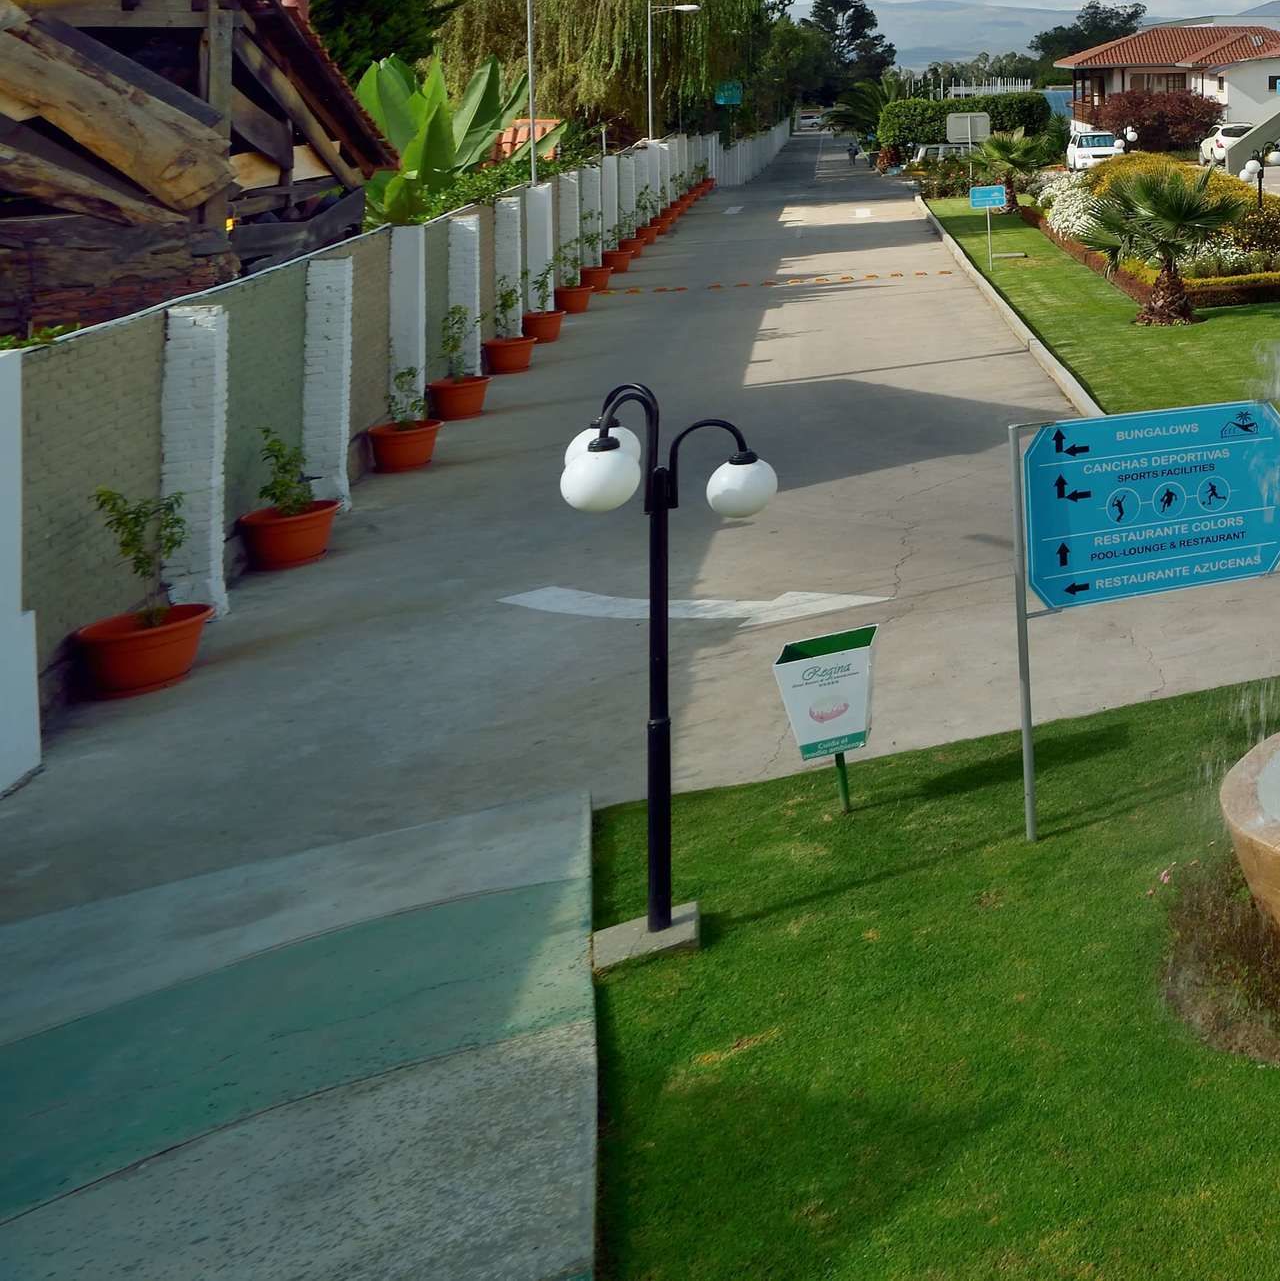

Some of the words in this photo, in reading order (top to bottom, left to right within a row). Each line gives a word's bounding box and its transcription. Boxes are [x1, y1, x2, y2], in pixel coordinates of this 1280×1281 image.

[1116, 423, 1199, 441] BUNGALOWS
[1083, 458, 1148, 474] CANCHAS
[1152, 448, 1230, 466] DEPORTIVAS
[1118, 470, 1159, 484] SPORTS
[1161, 463, 1215, 477] FACILITIES
[1094, 524, 1189, 546] RESTAURANTE
[1192, 516, 1244, 532] COLORS
[1090, 543, 1167, 561] POOL-LOUNGE
[1169, 541, 1177, 550] &
[1179, 531, 1246, 548] RESTAURANT
[1095, 566, 1190, 589] RESTAURANTE
[1193, 555, 1262, 575] AZUCENAS
